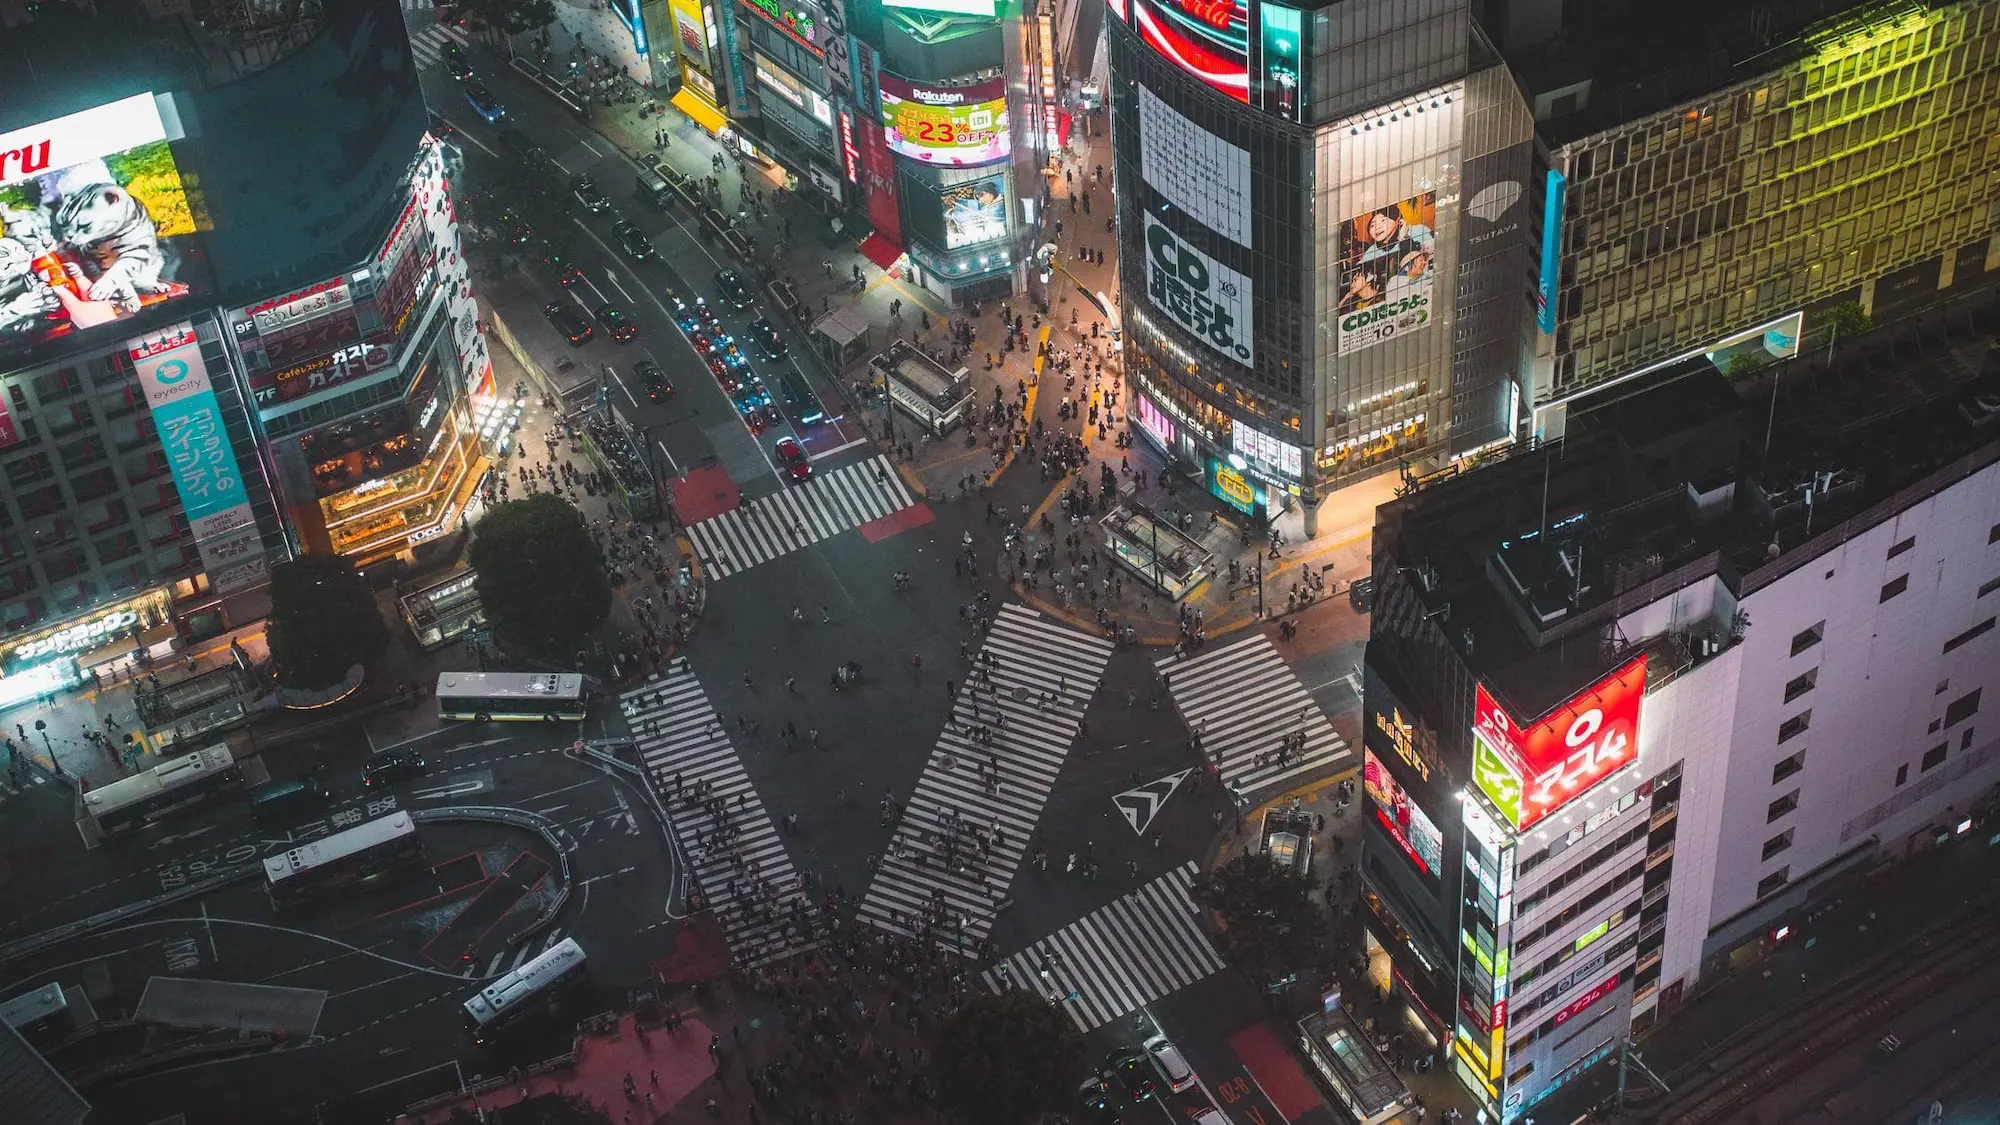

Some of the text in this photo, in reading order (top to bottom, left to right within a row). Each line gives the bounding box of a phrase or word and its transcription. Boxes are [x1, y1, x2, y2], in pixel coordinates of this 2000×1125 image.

[913, 88, 964, 102] Rakuten
[1469, 223, 1520, 245] TSUTAYA
[1147, 224, 1210, 292] CD
[235, 321, 253, 334] 9F
[1373, 325, 1394, 340] 10
[332, 343, 375, 365] ガスト
[308, 361, 360, 389] ガスト
[153, 379, 202, 400] eyecity
[255, 387, 276, 402] 7F
[1139, 373, 1215, 441] STARBUCKS
[1325, 413, 1425, 456] STARBUCKS
[163, 414, 211, 497] アイシティ
[193, 407, 235, 491] コンタクトの
[1250, 469, 1285, 489] TSUTAYA
[203, 510, 238, 526] CONTACT
[213, 519, 233, 529] LENS
[1481, 710, 1520, 765] アコム
[1534, 731, 1627, 801] アコム
[1572, 990, 1600, 1012] アコム
